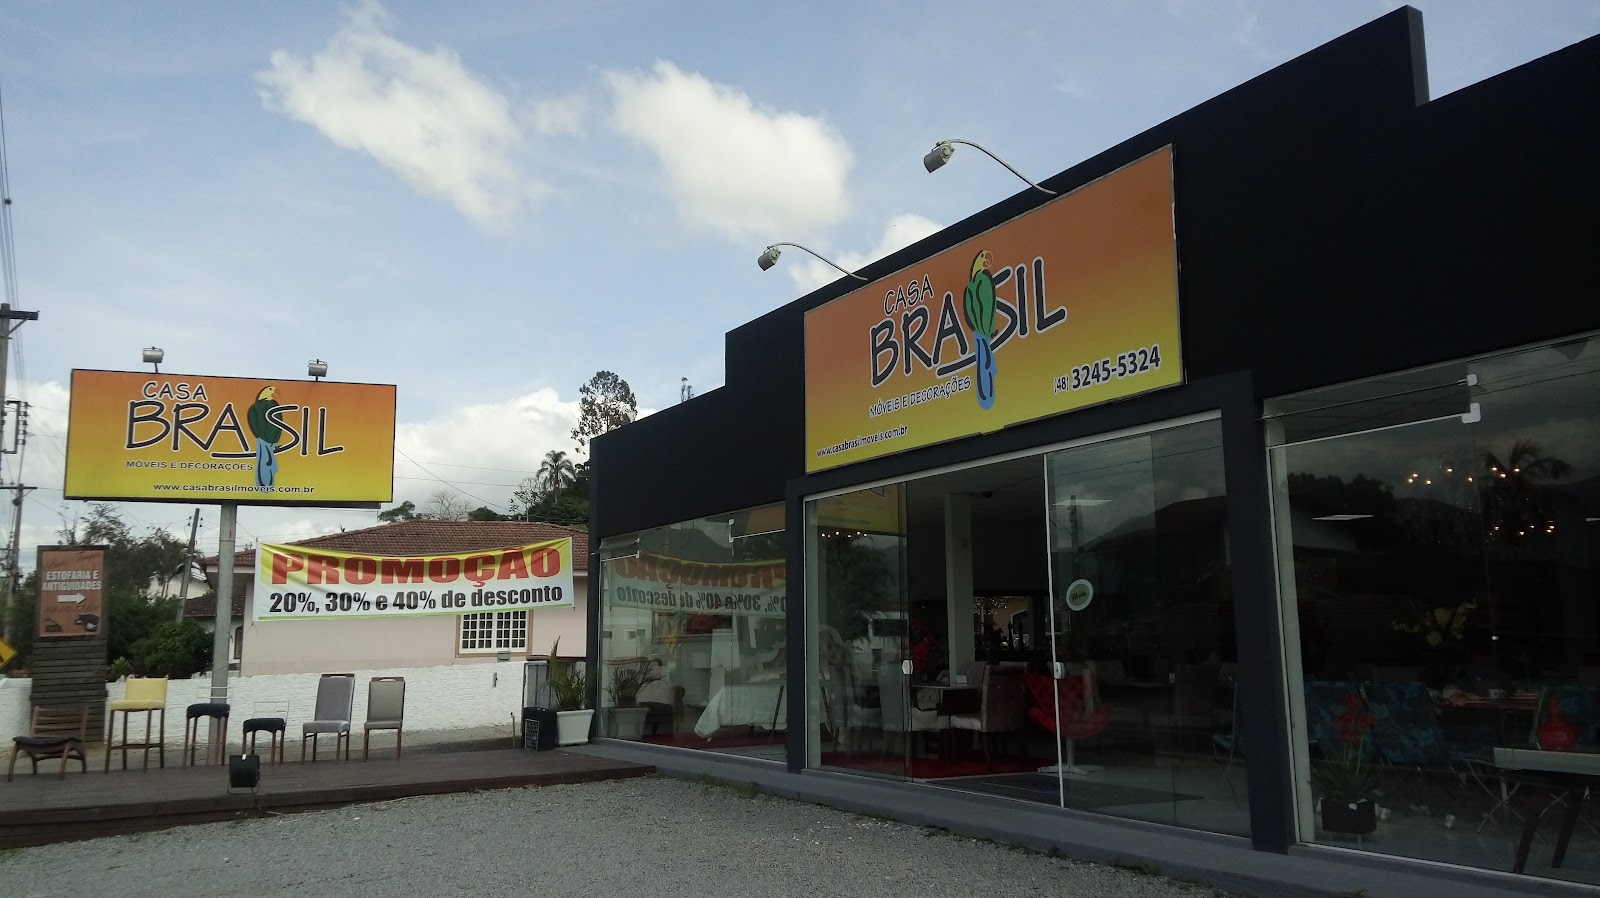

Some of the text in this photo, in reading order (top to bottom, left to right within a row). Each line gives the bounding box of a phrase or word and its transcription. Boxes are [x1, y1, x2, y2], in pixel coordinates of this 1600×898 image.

[884, 274, 934, 315] CASA
[870, 256, 1067, 388] BRASIL
[1054, 345, 1160, 394] (48) 3245-5324
[142, 381, 208, 401] CASA
[870, 376, 971, 417] MÓVEIS E DECORAÇÕES
[125, 400, 344, 458] BRASIL
[816, 424, 908, 458] www.casabrasilmoveis.com.br
[170, 461, 177, 469] E
[153, 483, 315, 493] www.casabrasilmoveis.com.br
[46, 570, 99, 581] ESTOFARIA E
[272, 546, 560, 588] PROMOÇÃO
[42, 581, 102, 591] ANTIGUIDADES
[269, 585, 563, 614] 20%, 30% e 40% de desconto
